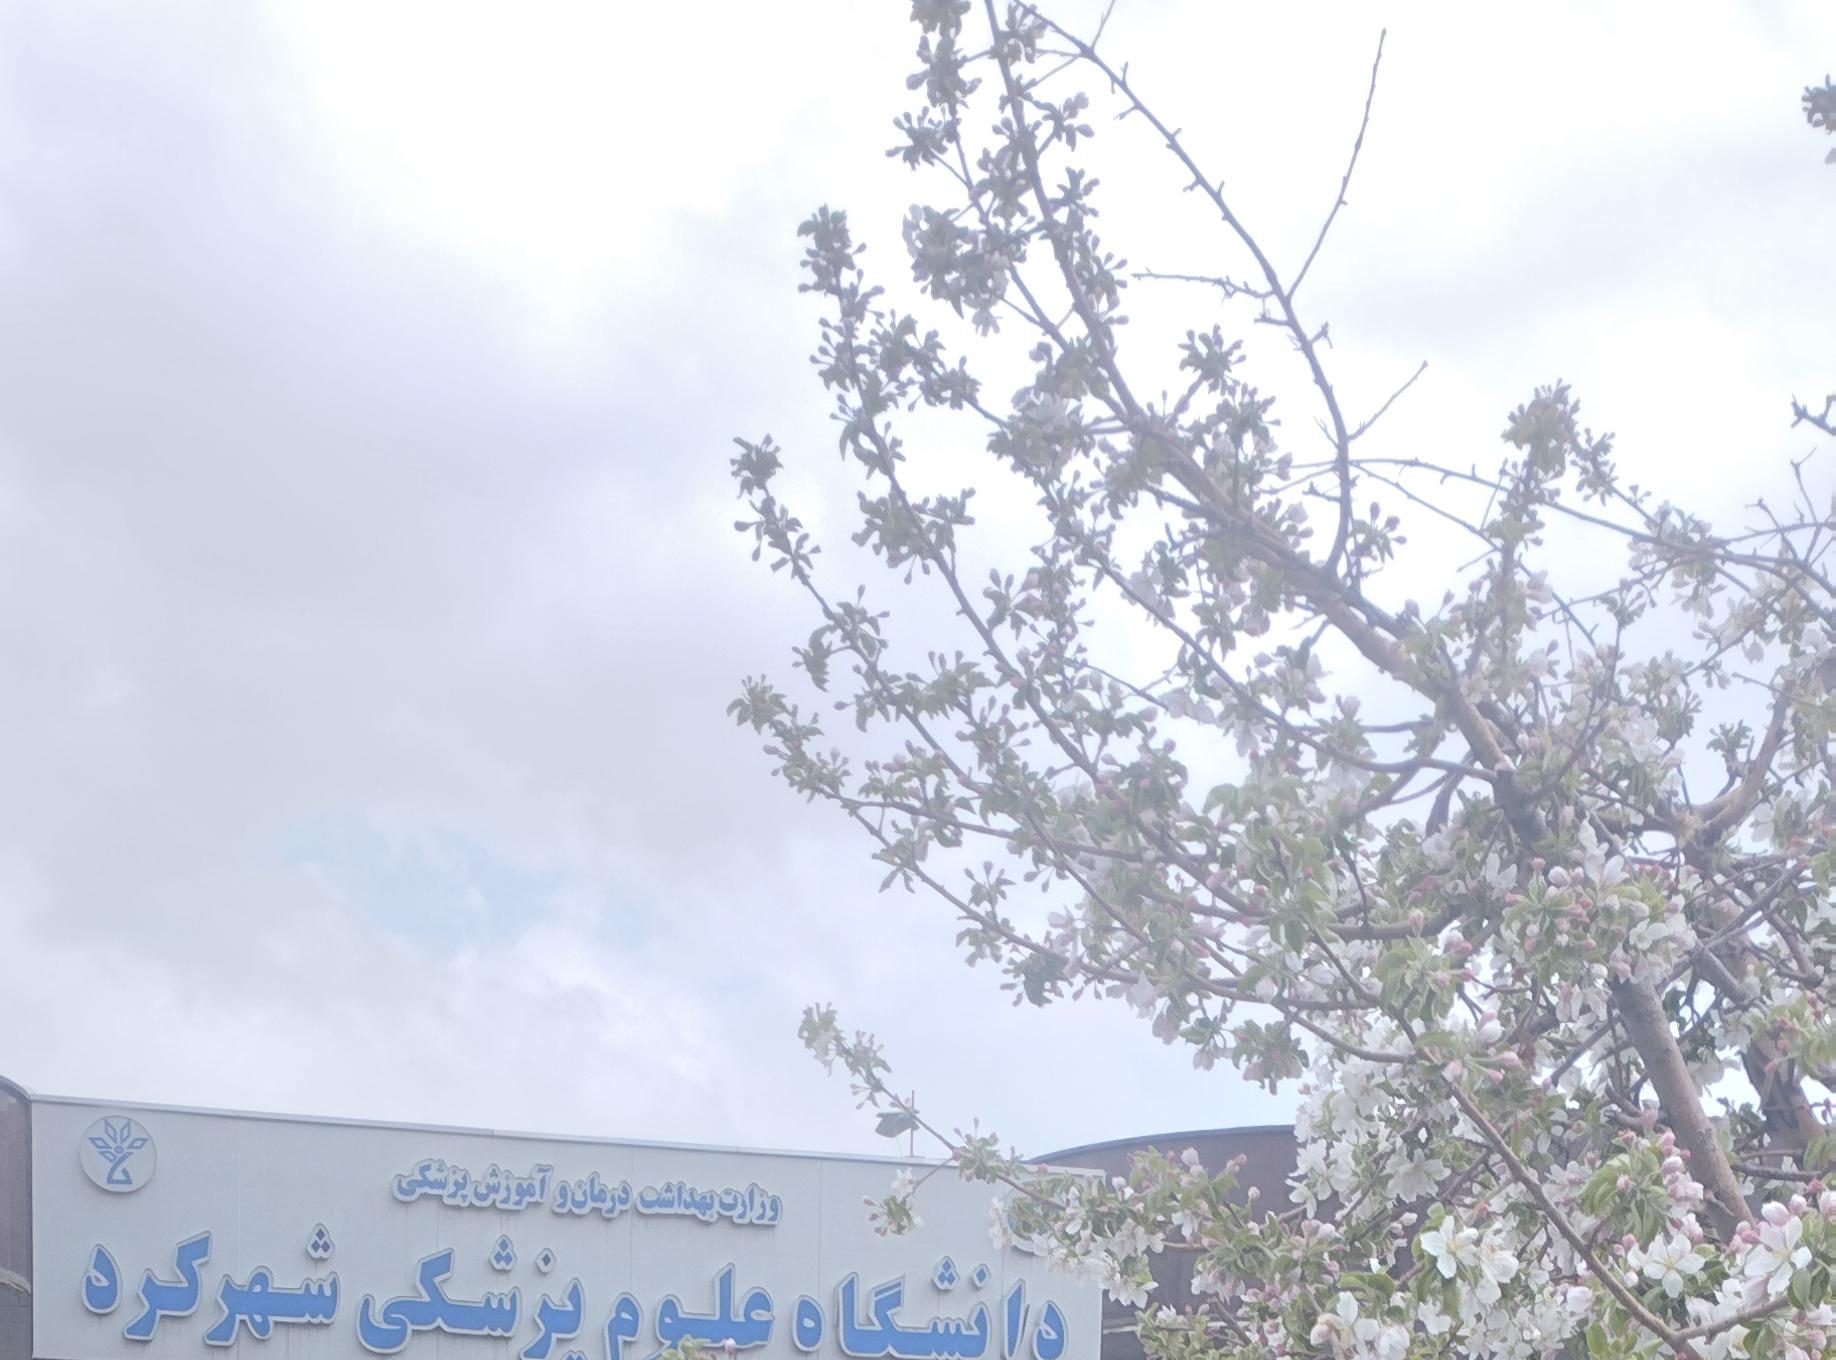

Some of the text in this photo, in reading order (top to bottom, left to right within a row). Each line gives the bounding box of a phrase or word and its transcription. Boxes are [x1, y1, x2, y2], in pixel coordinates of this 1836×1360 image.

[397, 1162, 779, 1222] وزارت بهداشت درمان و آموزش پزشکی
[84, 1228, 338, 1343] شهرکرد
